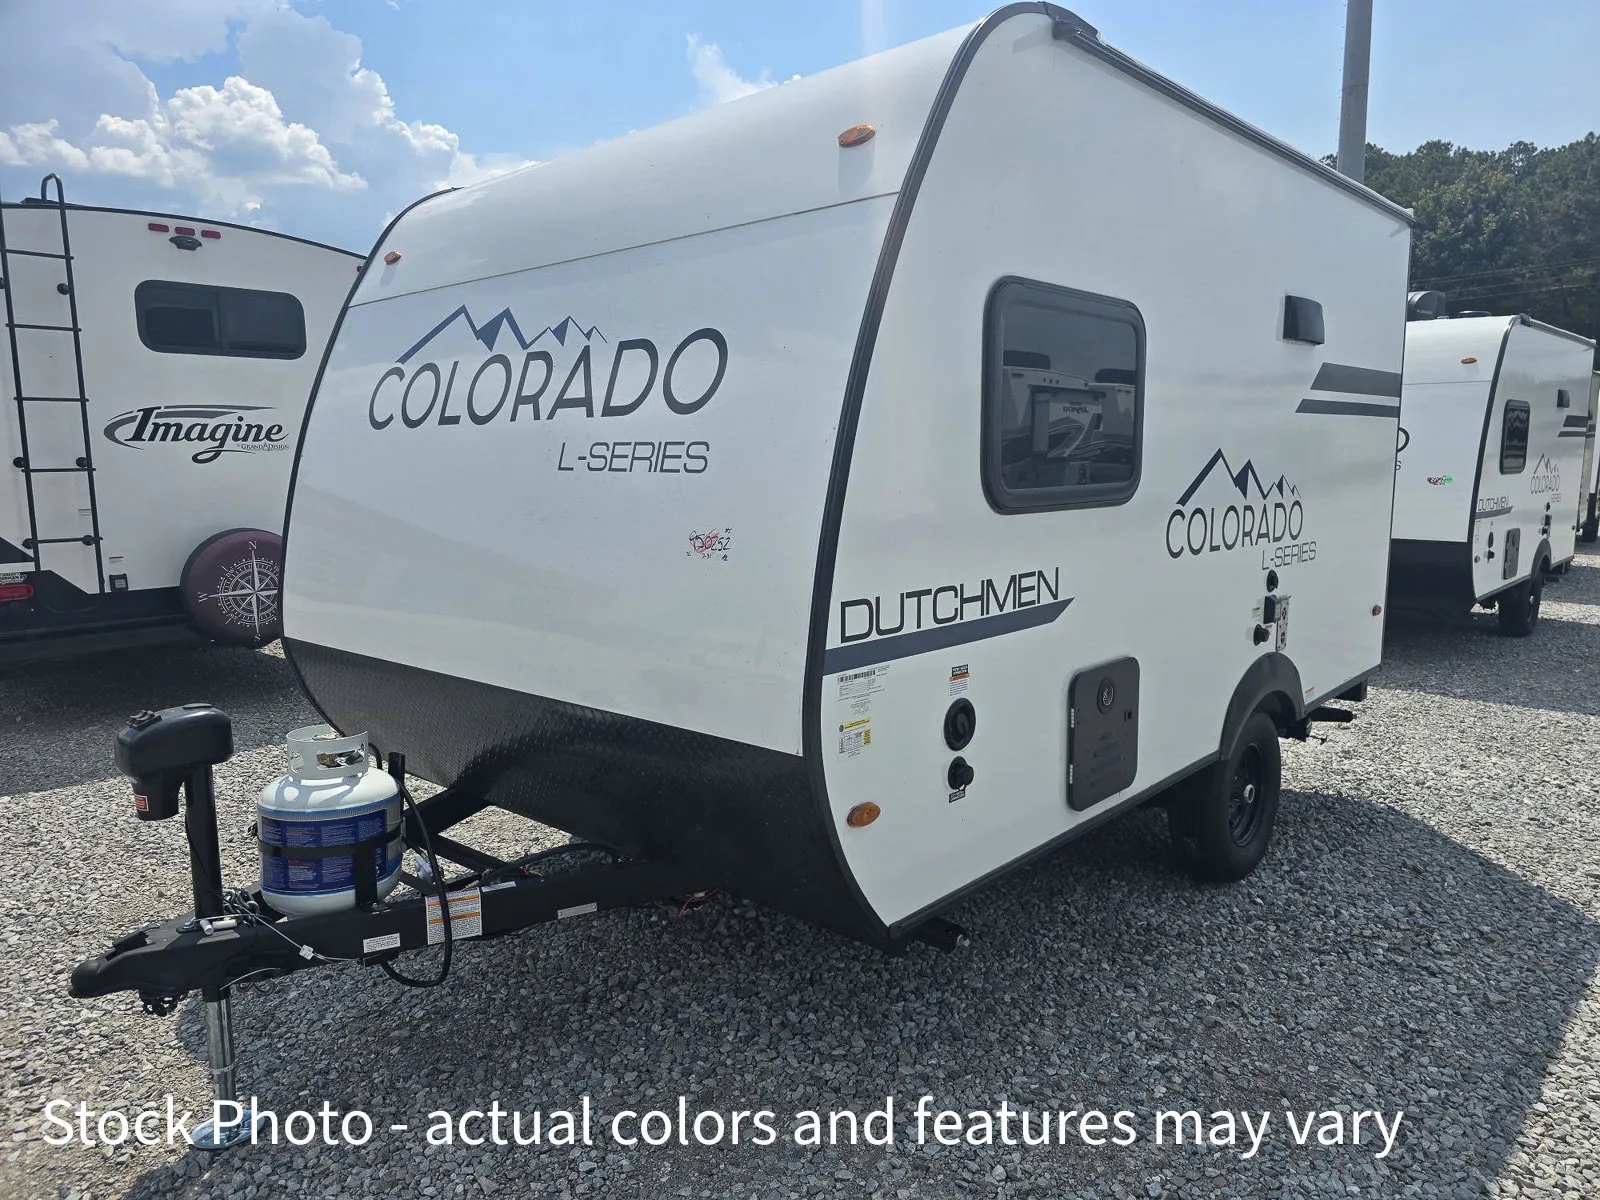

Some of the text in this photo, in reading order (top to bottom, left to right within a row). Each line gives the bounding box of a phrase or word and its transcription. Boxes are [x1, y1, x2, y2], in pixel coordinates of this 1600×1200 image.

[369, 328, 728, 430] COLORADO
[124, 406, 290, 464] Imagine
[557, 441, 710, 474] L-SERIES
[1166, 500, 1304, 559] COLORADO
[1262, 541, 1317, 571] L-SERIES
[840, 566, 1059, 644] DUTCHMEN
